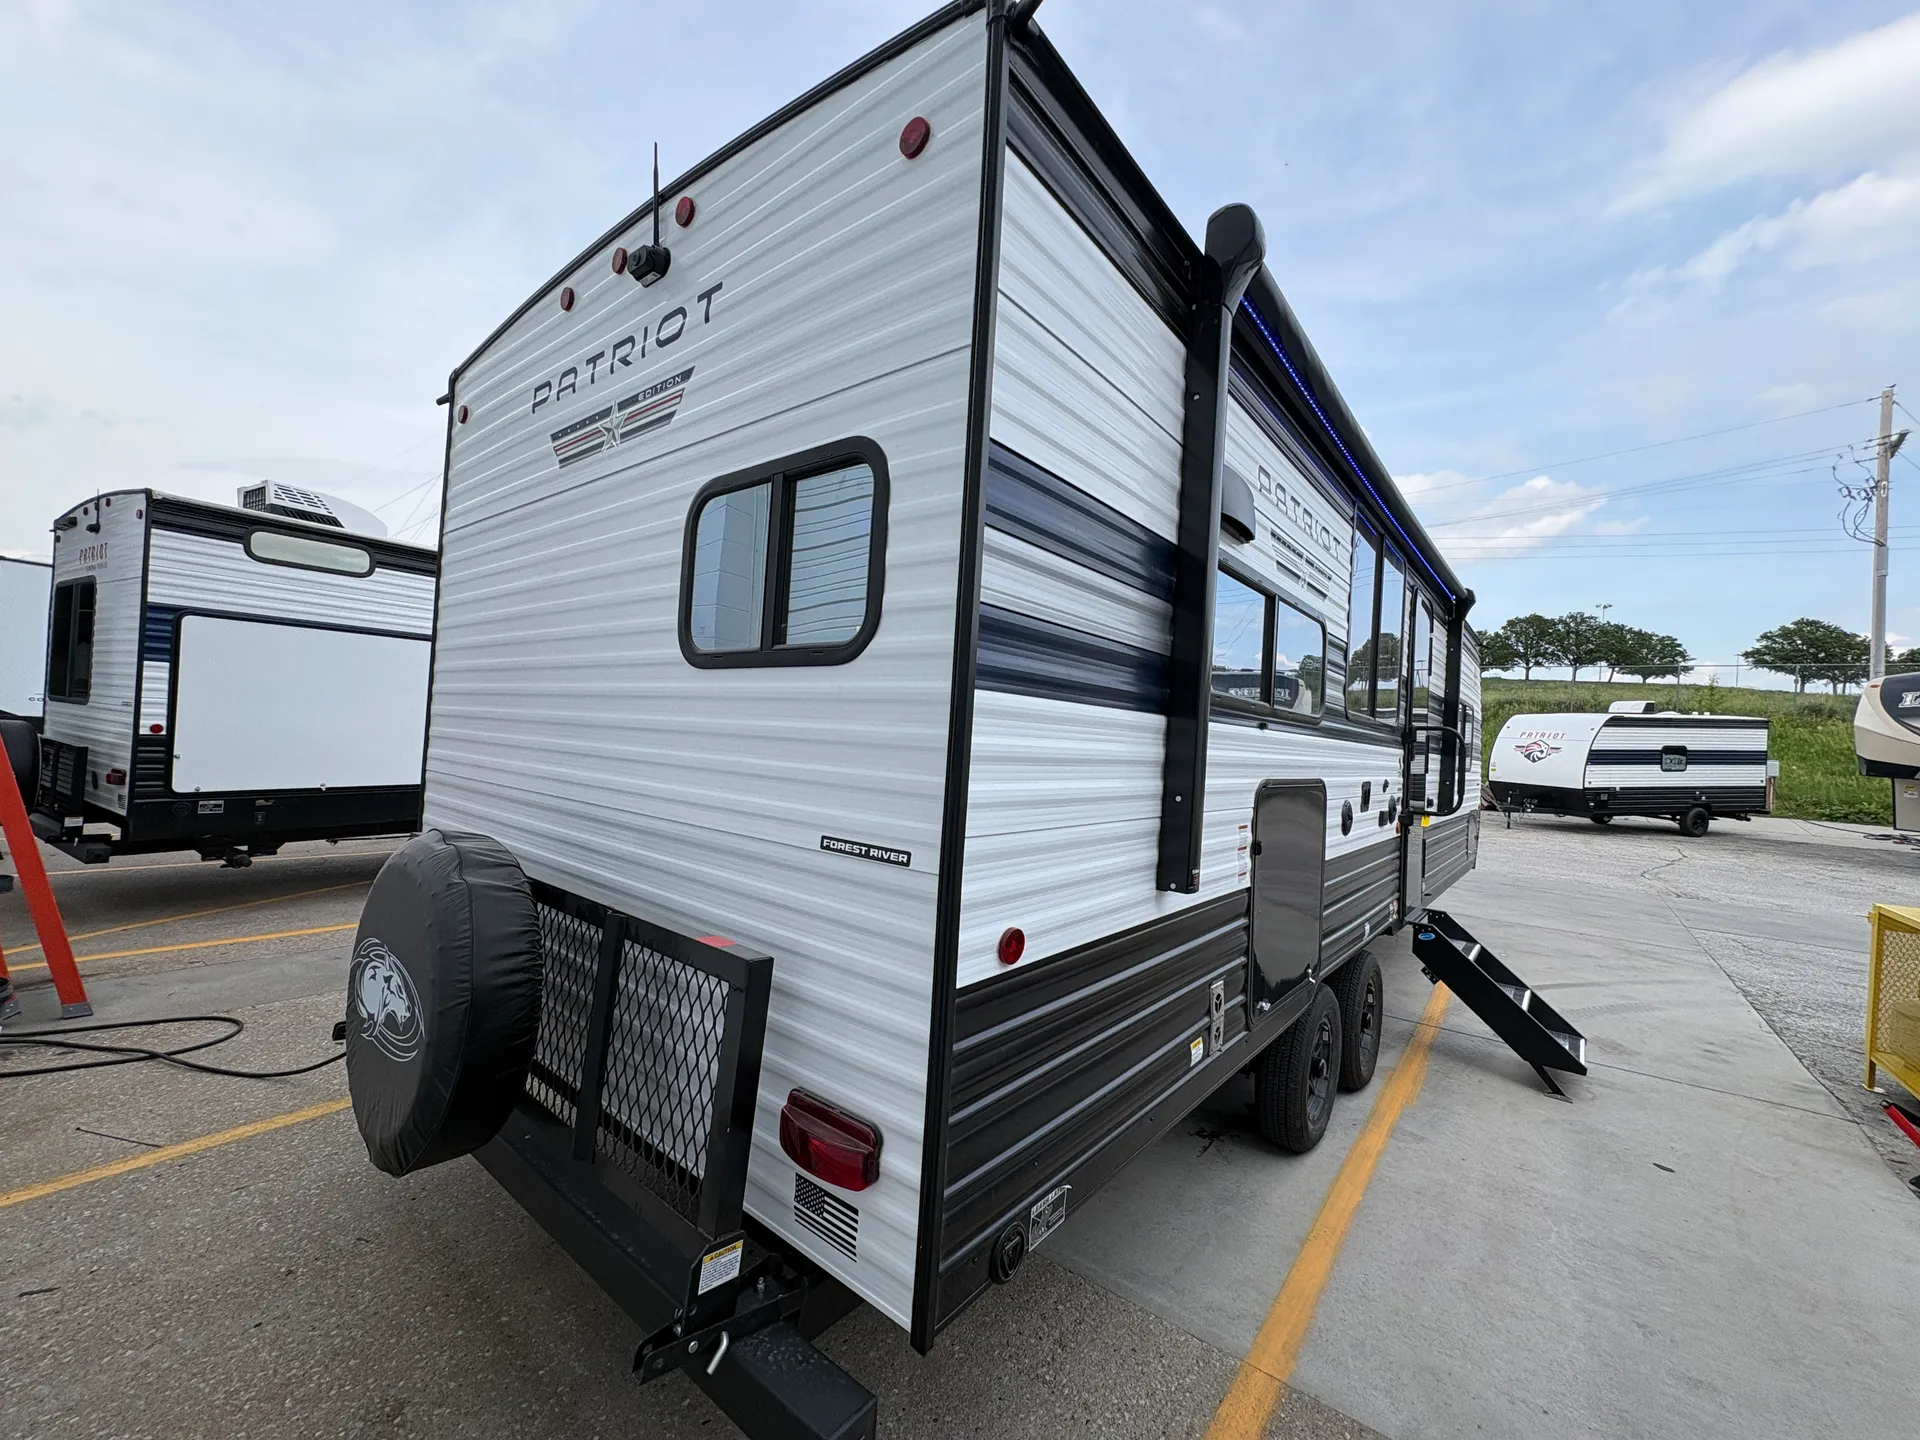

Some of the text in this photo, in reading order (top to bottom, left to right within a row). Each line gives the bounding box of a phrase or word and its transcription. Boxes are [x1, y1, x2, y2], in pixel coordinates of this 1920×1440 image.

[532, 281, 723, 414] PATRIOT
[637, 375, 682, 401] EDITION
[1258, 464, 1341, 561] PATRIOT
[79, 542, 108, 565] PATRIOT
[1519, 732, 1567, 740] PATRIOT
[823, 839, 908, 863] FOREST RIVER
